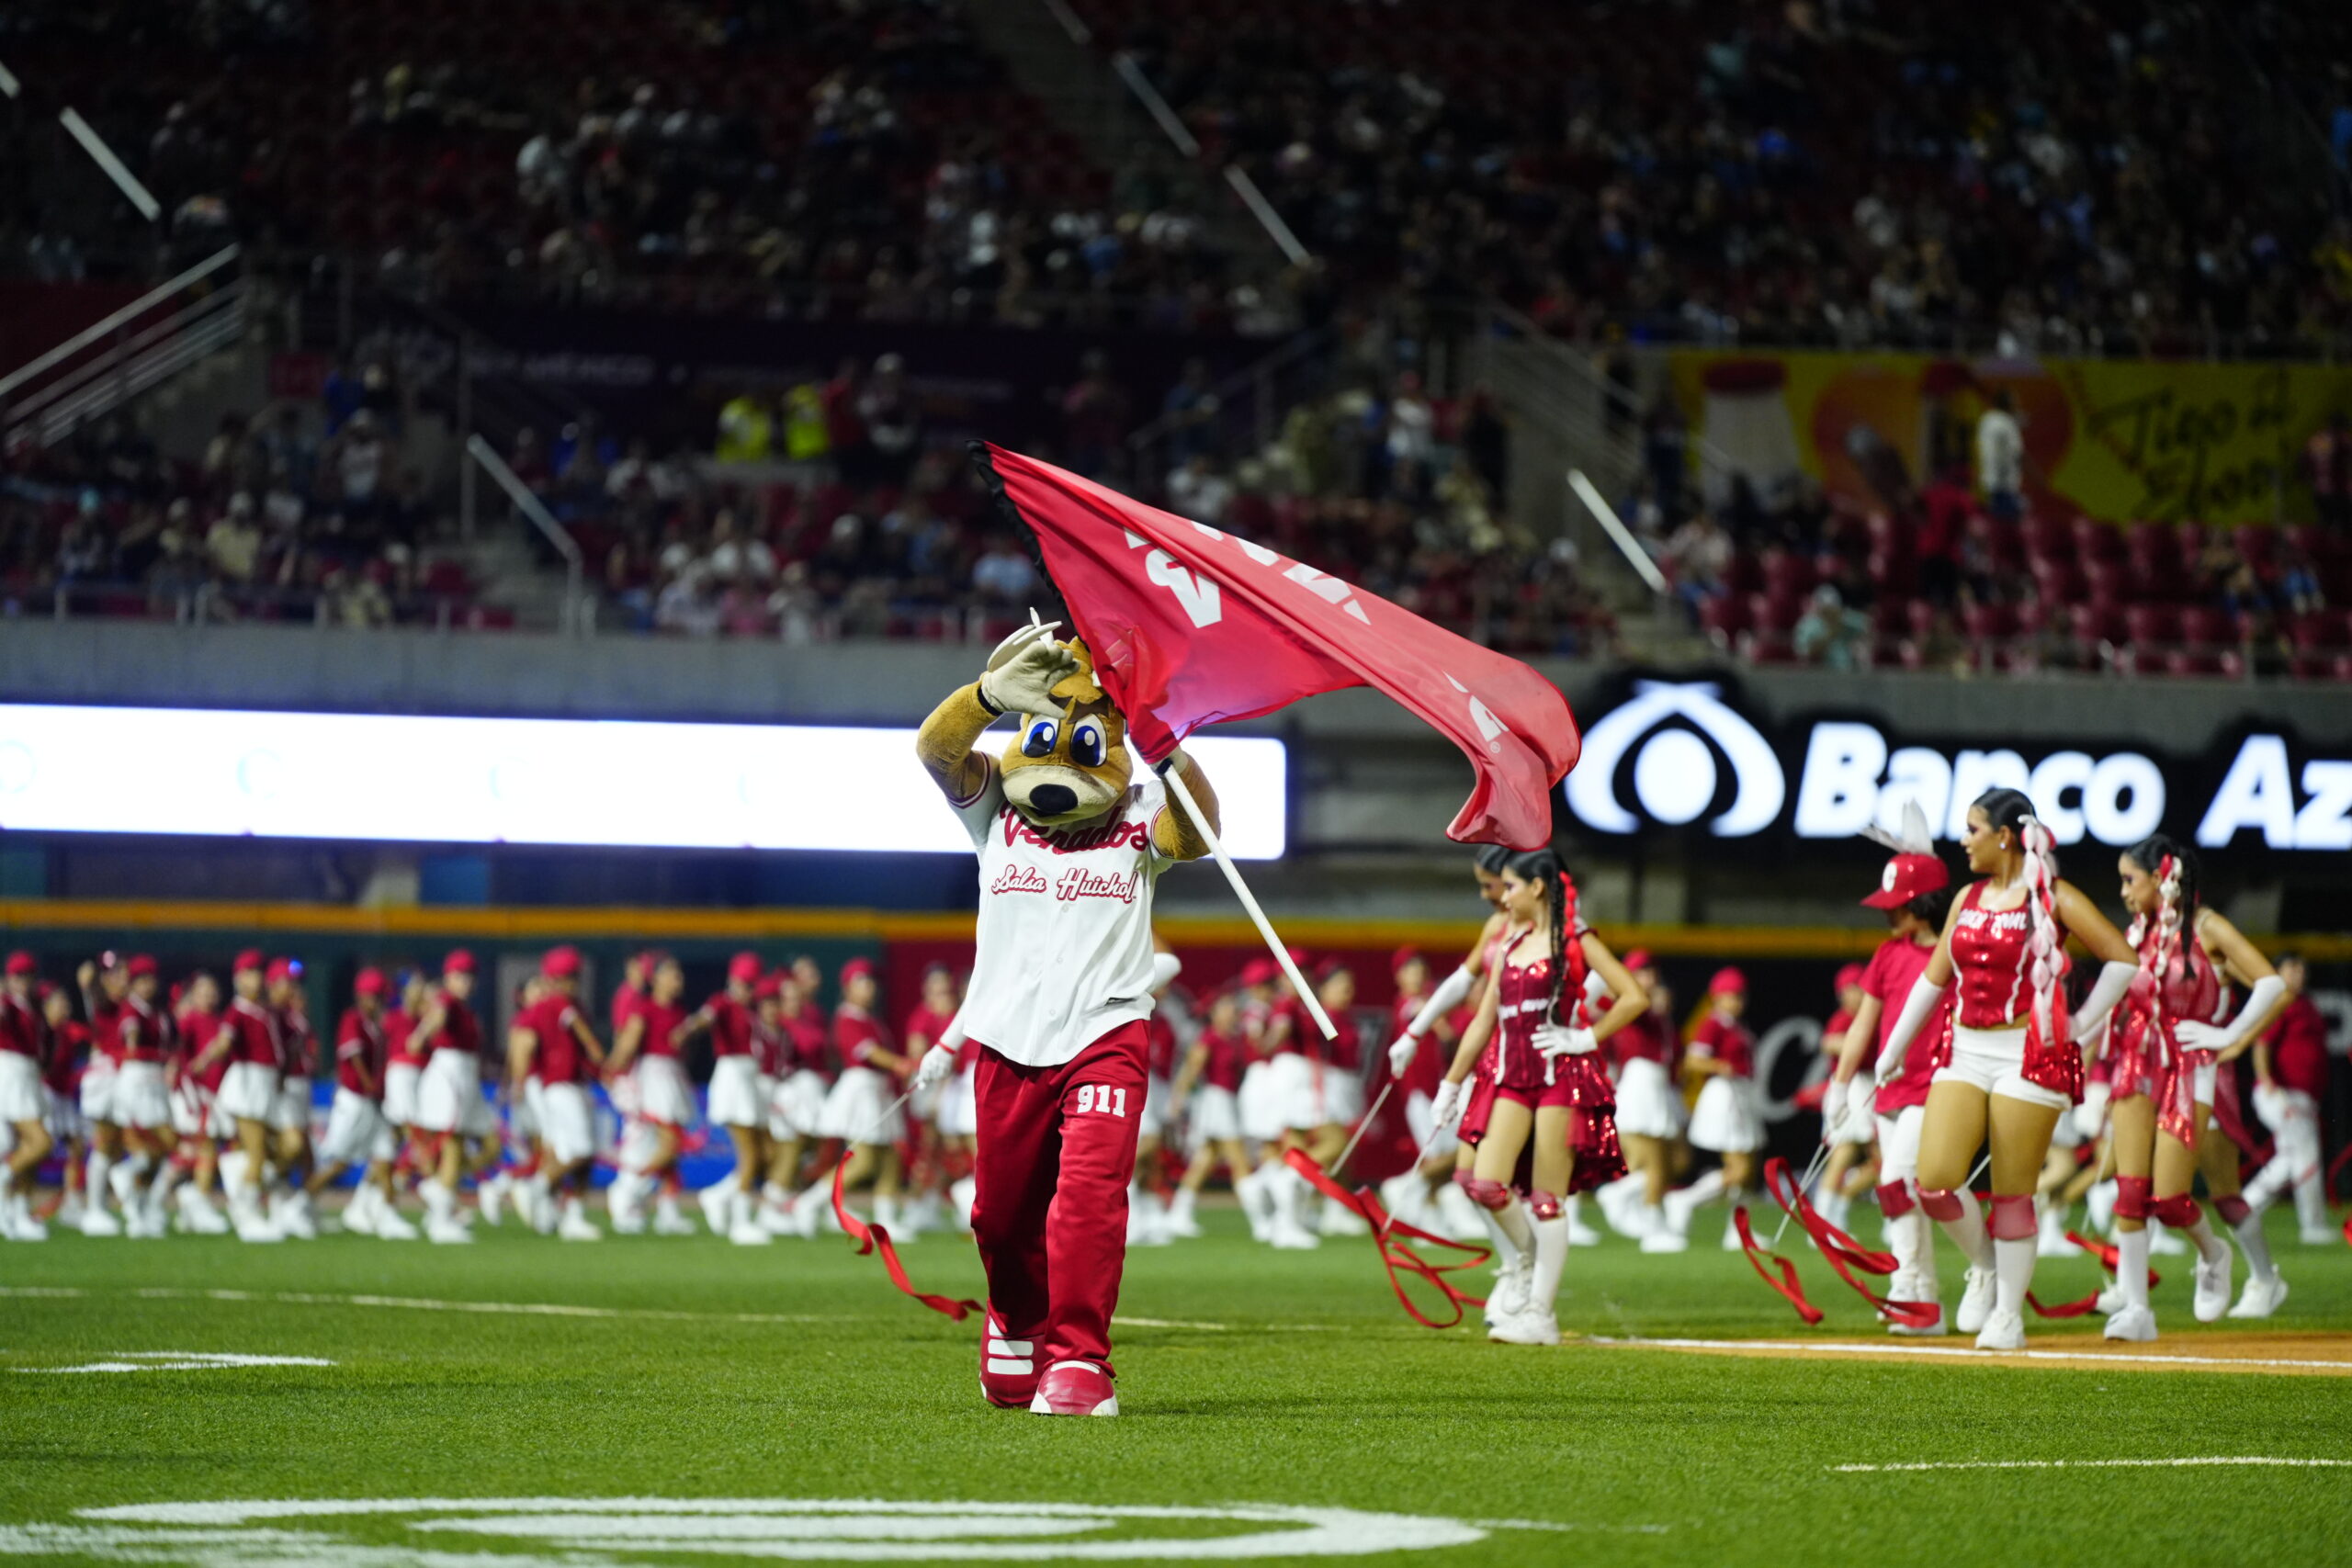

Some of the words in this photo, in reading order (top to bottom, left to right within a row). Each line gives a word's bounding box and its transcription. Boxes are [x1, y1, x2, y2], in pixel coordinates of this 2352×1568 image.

[1794, 721, 2165, 845] Banco
[2196, 734, 2352, 850] Az
[1000, 804, 1148, 854] Venados
[991, 864, 1046, 895] Salsa
[1057, 868, 1138, 904] Huichol
[1077, 1085, 1125, 1118] 911
